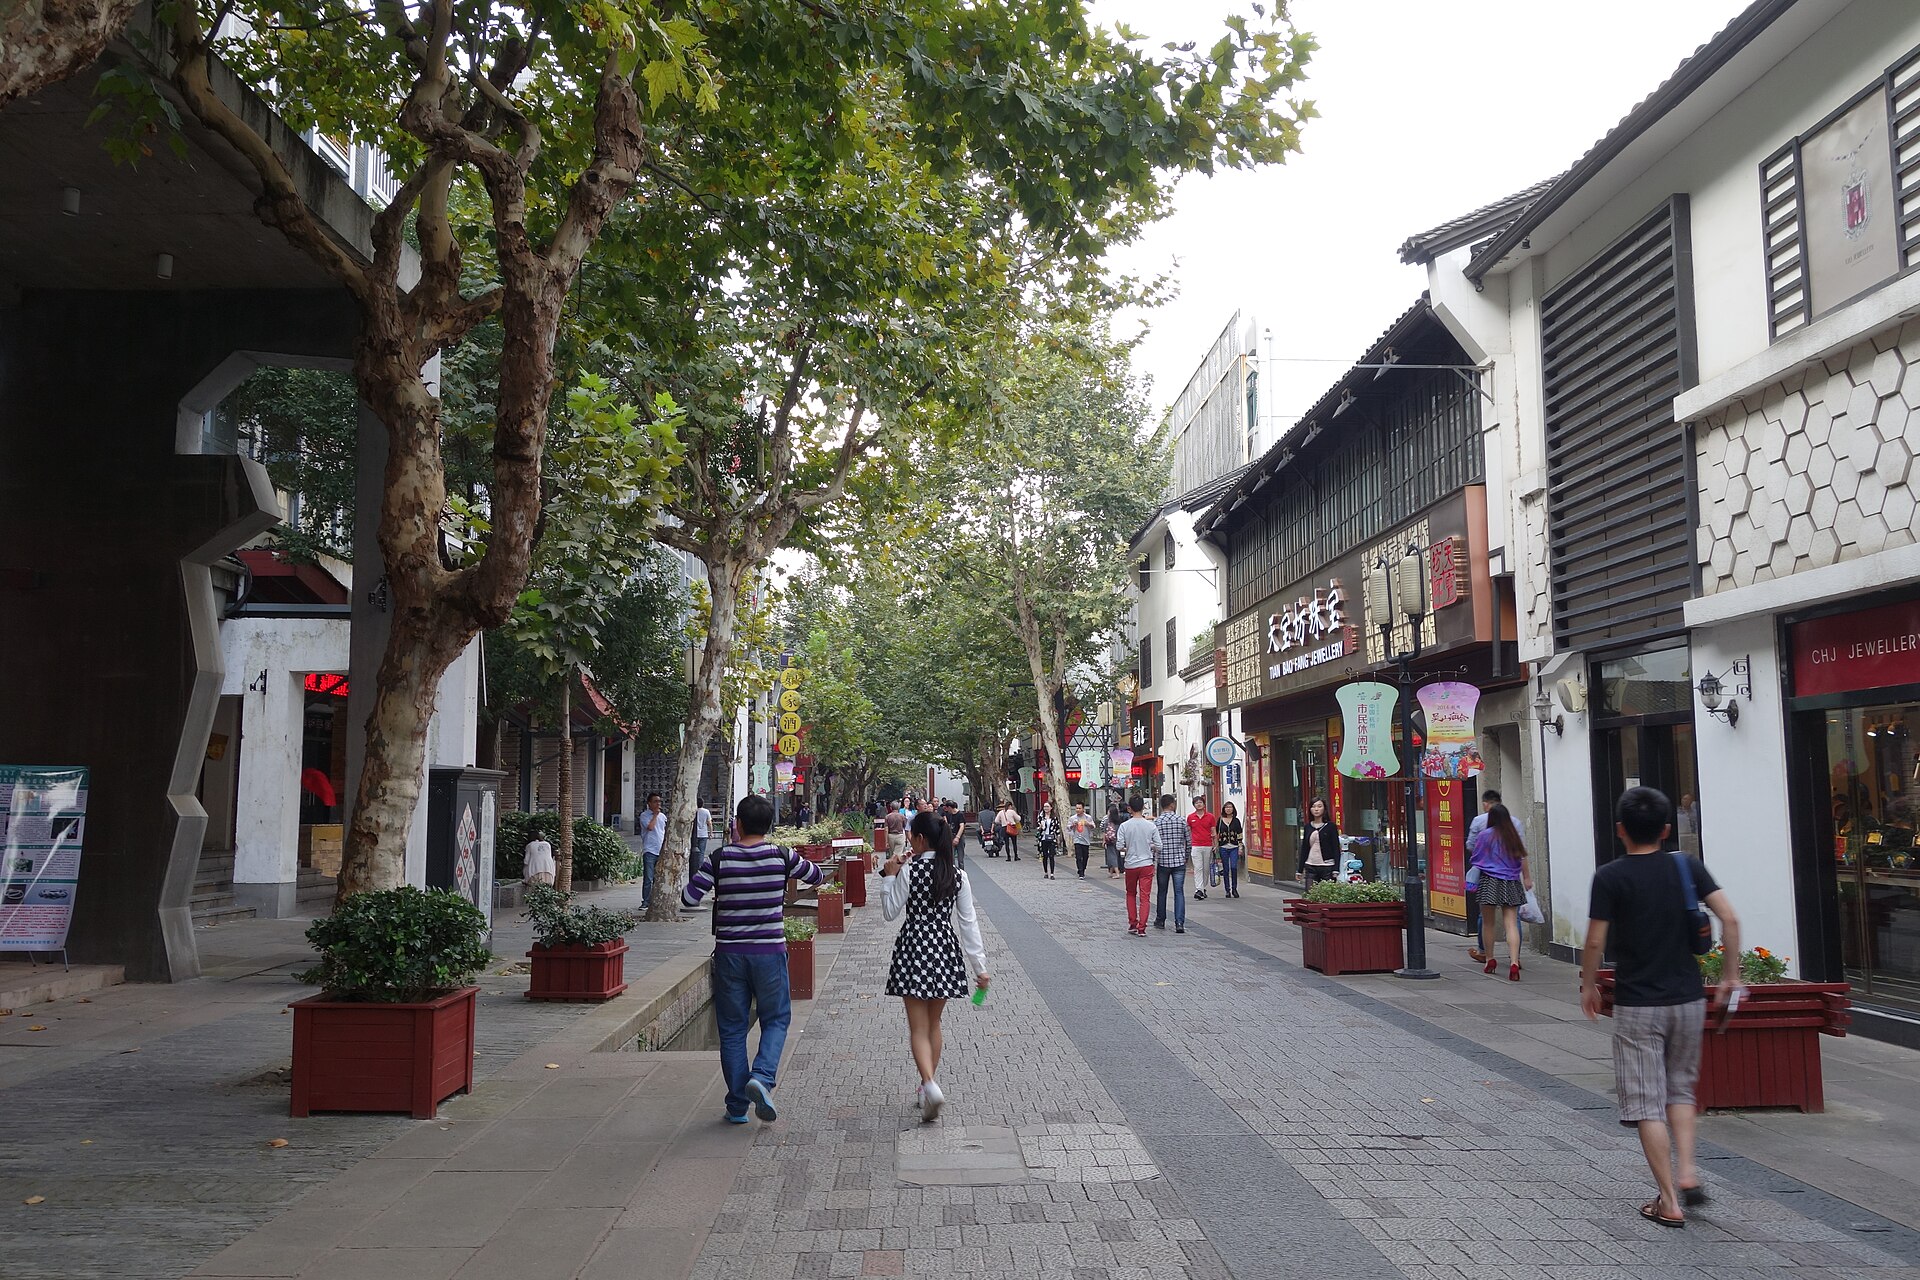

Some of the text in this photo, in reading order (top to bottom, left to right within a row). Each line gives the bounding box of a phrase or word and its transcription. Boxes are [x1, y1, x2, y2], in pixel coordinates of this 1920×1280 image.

[1267, 578, 1339, 654] 天宝坊珠宝
[1269, 641, 1343, 679] TIAN BAO FANG JEWELLERY
[1812, 634, 1920, 664] CHJ JEWELLER
[782, 672, 801, 753] 如家酒店
[1357, 703, 1368, 755] 市民休闲节
[1439, 811, 1451, 822] STORE
[1440, 801, 1449, 811] GOLD
